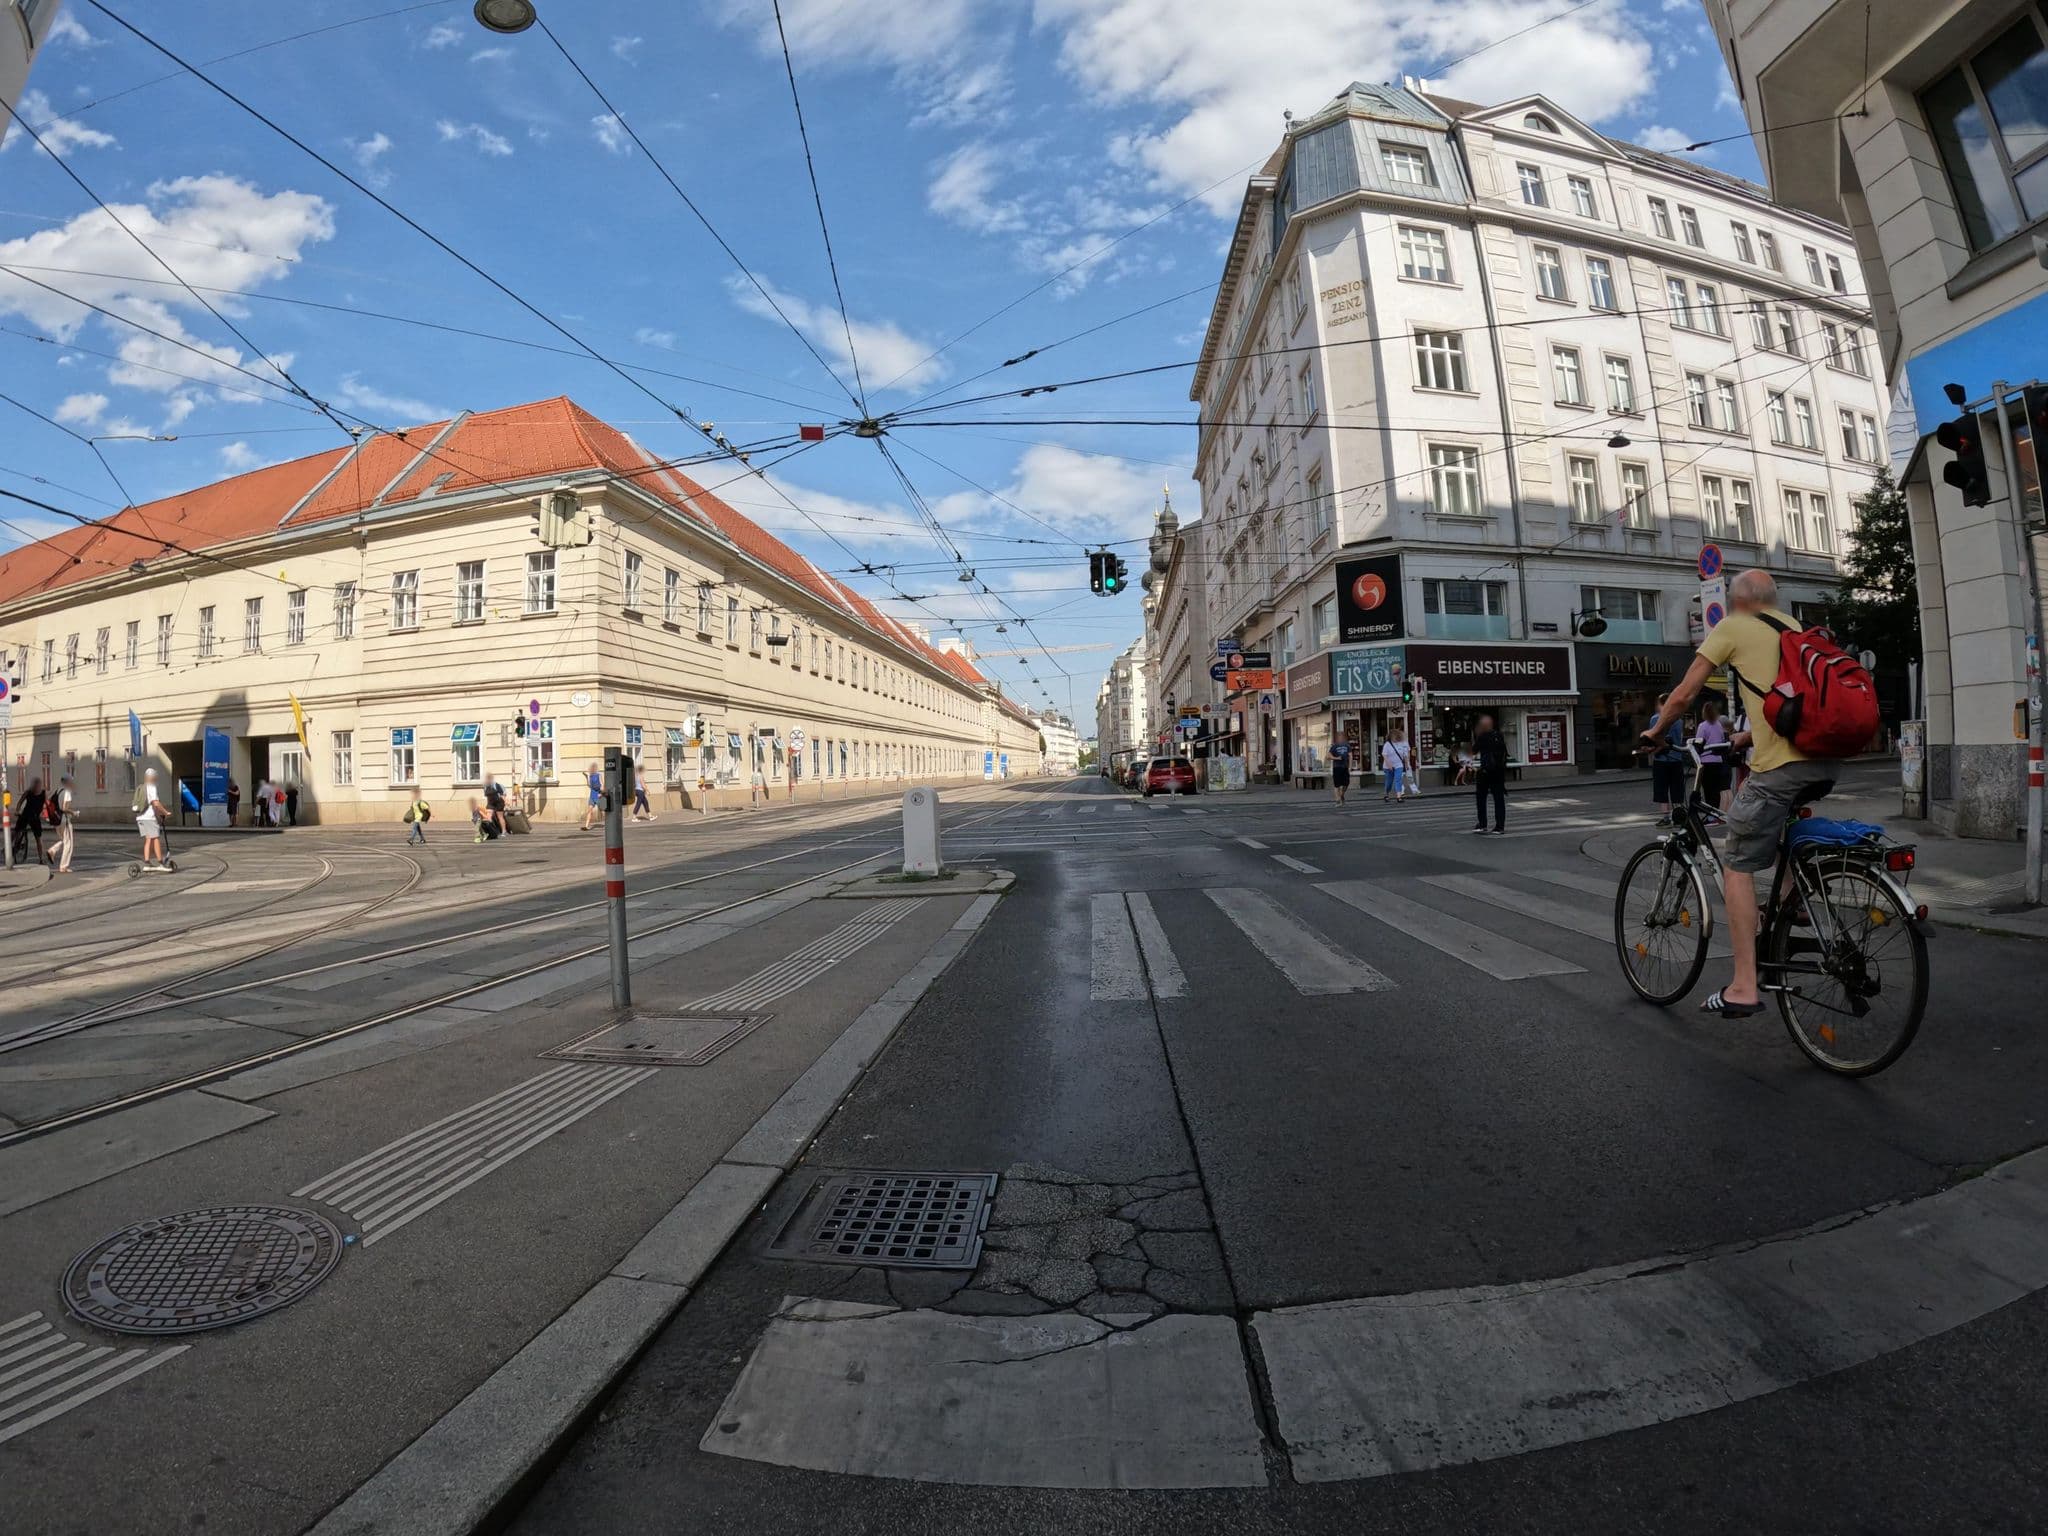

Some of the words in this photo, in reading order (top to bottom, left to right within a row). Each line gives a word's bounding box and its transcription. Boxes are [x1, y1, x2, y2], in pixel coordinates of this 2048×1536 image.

[1331, 296, 1362, 313] ZENZ
[1347, 624, 1394, 635] SHINERGY
[1437, 660, 1546, 675] EIBENSTEINER
[1337, 666, 1363, 693] EIS
